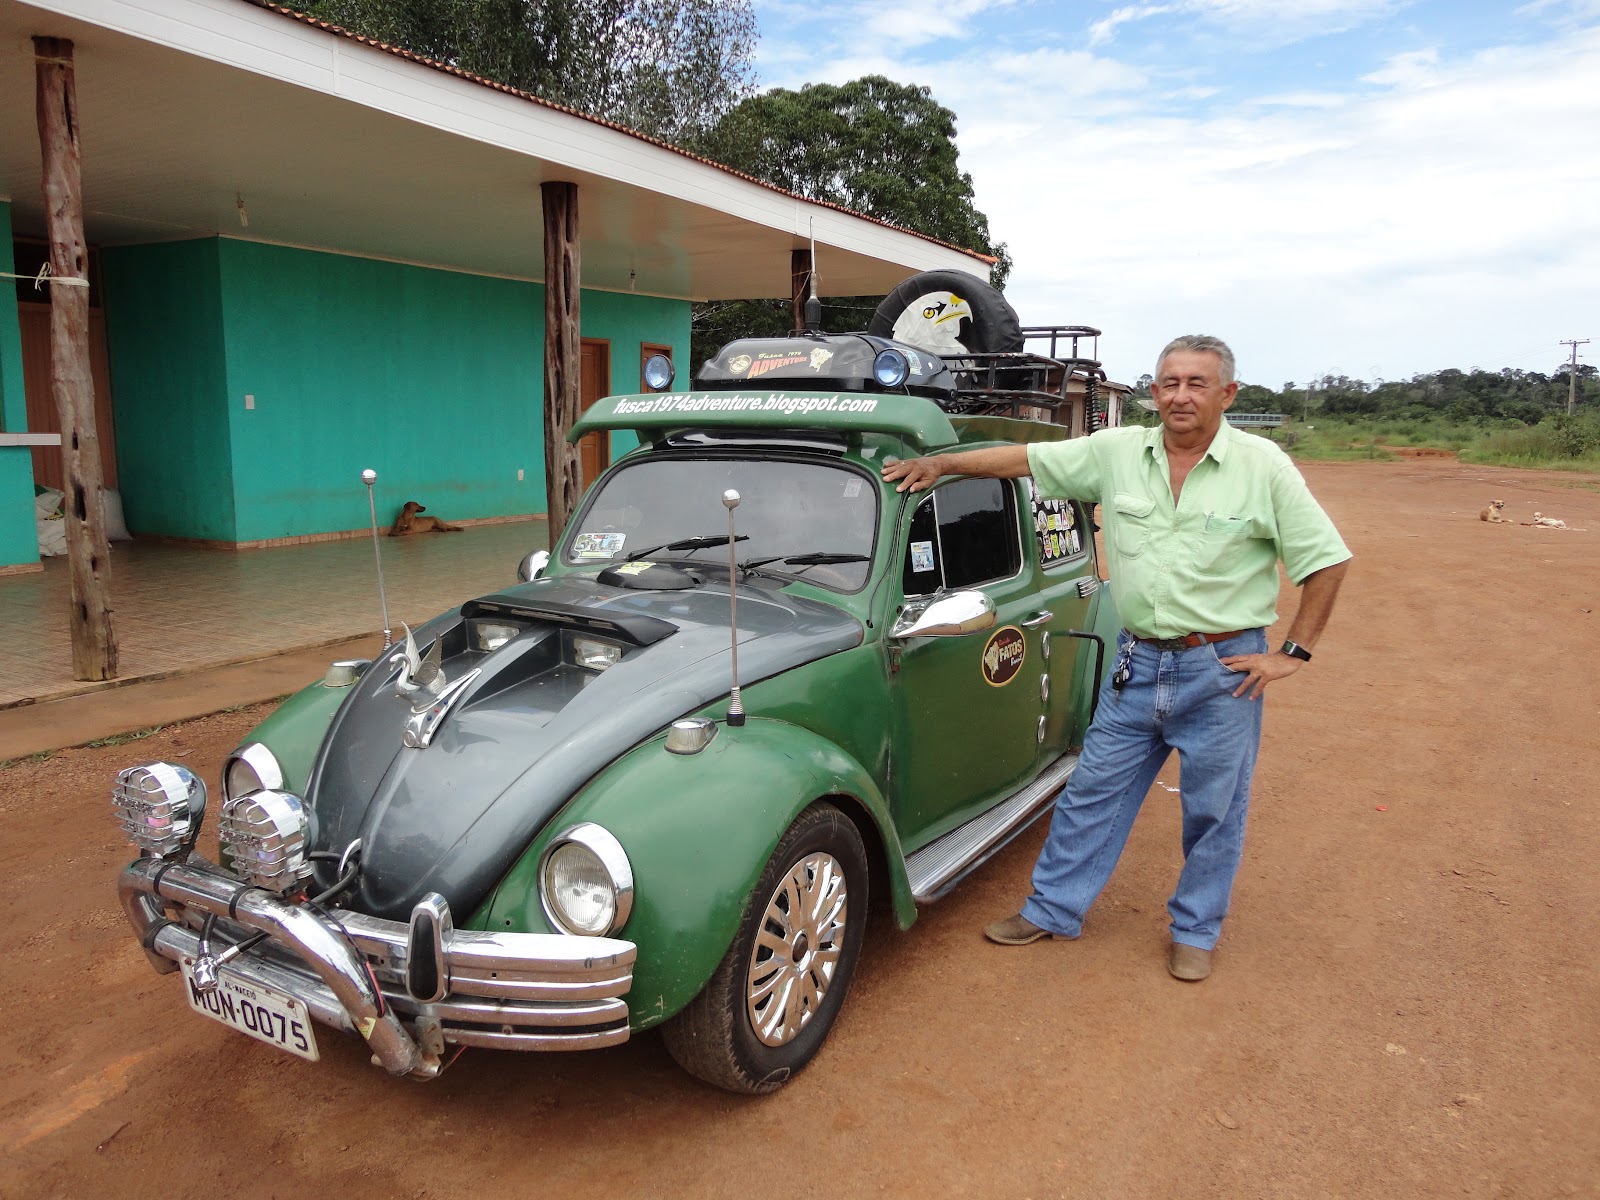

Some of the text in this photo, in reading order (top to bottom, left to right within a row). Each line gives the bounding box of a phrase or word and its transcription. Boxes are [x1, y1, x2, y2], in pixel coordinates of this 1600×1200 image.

[747, 357, 808, 380] ADVENTURE
[613, 394, 878, 415] fusca1974adventure.blogspot.com
[999, 638, 1023, 663] FATOS
